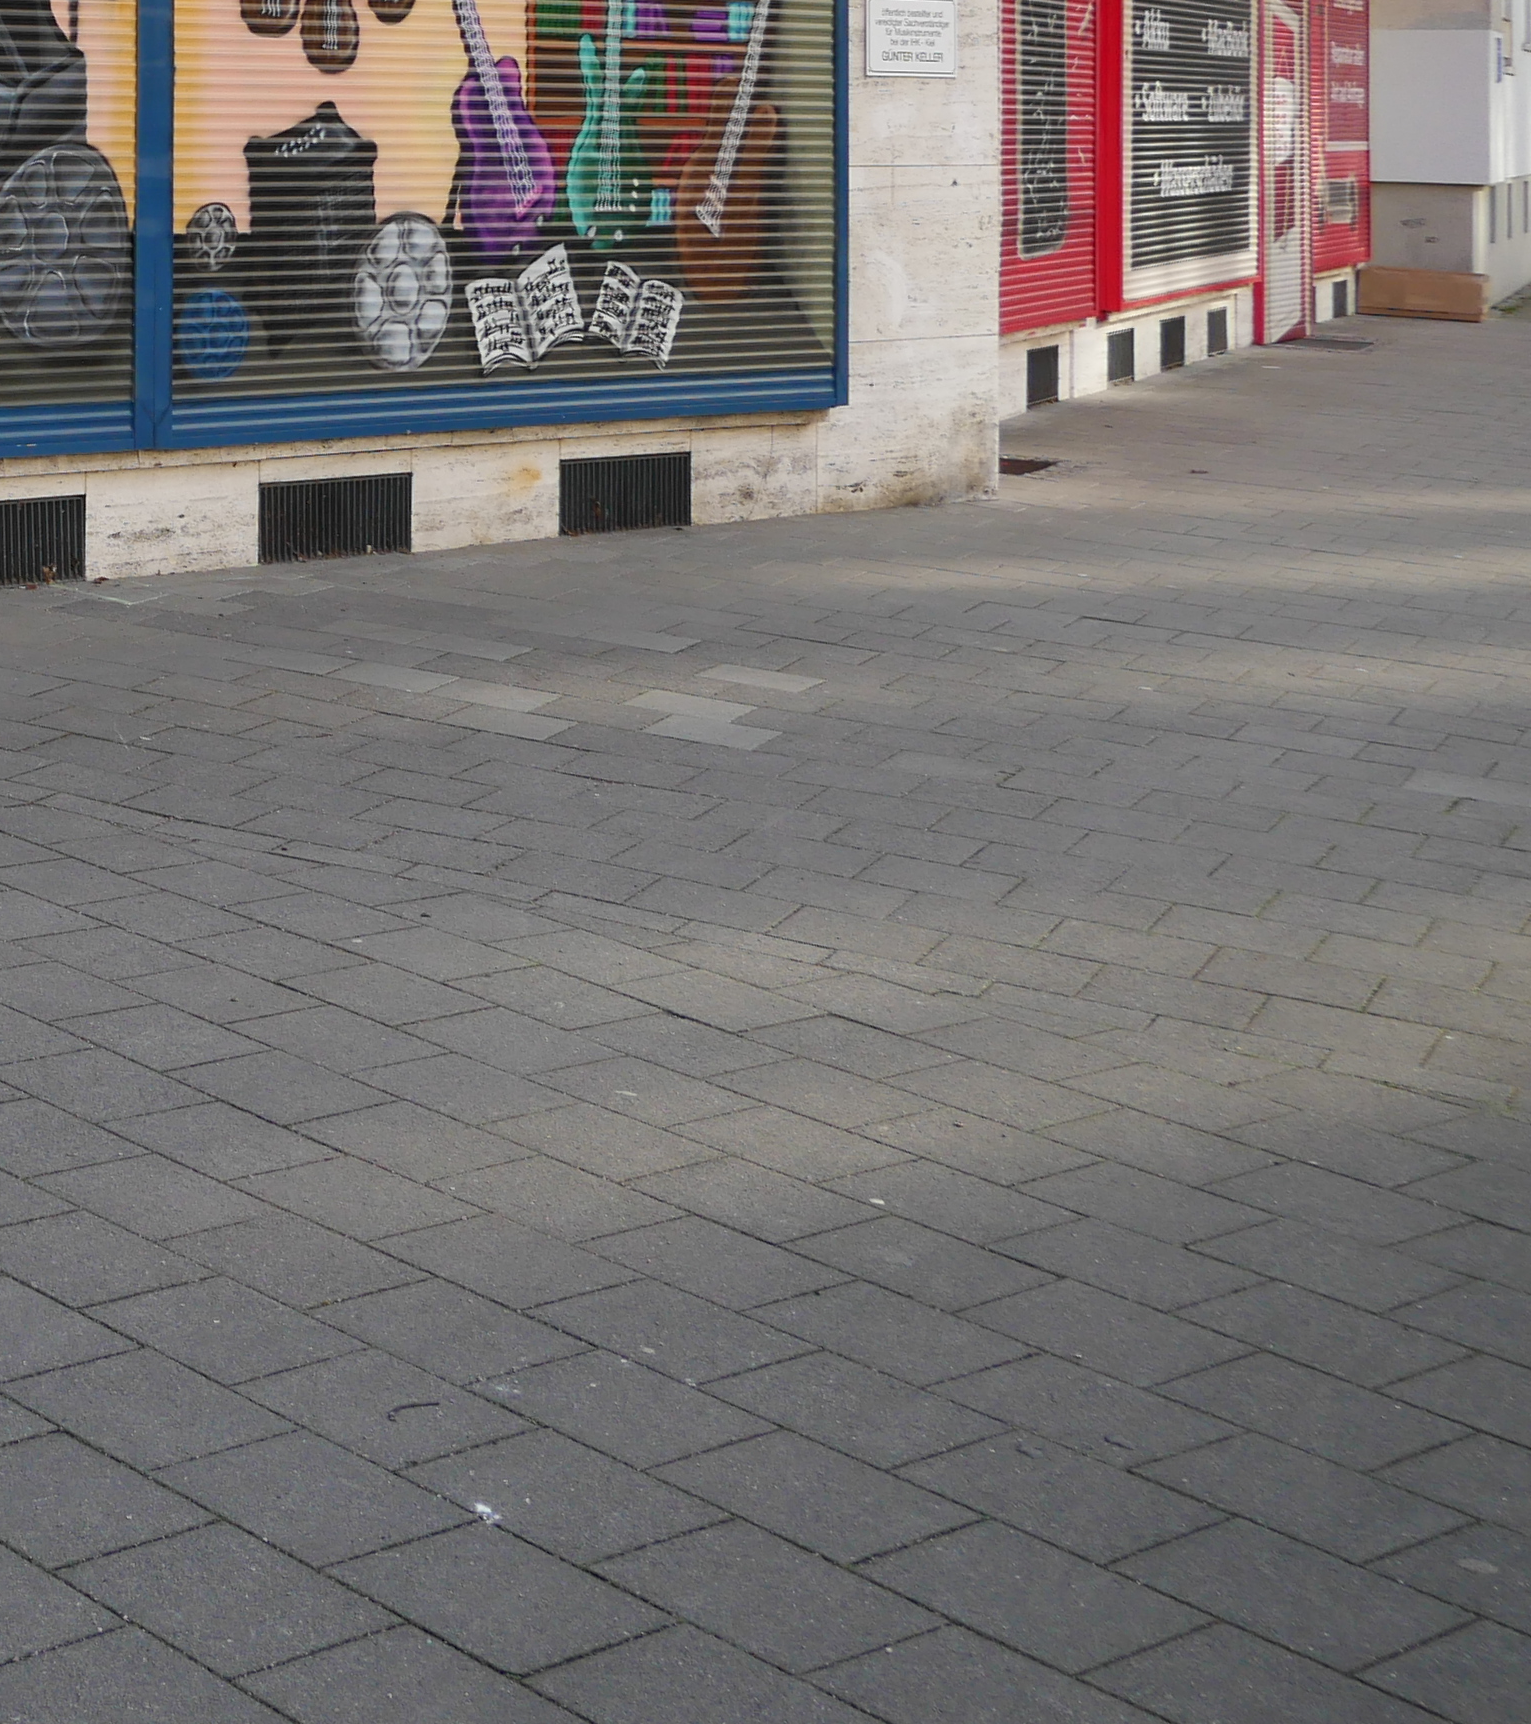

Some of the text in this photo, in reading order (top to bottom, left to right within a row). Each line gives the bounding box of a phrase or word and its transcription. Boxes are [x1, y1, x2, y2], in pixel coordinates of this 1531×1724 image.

[881, 49, 944, 63] GÜNTER KELLER
[1142, 80, 1189, 122] Software
